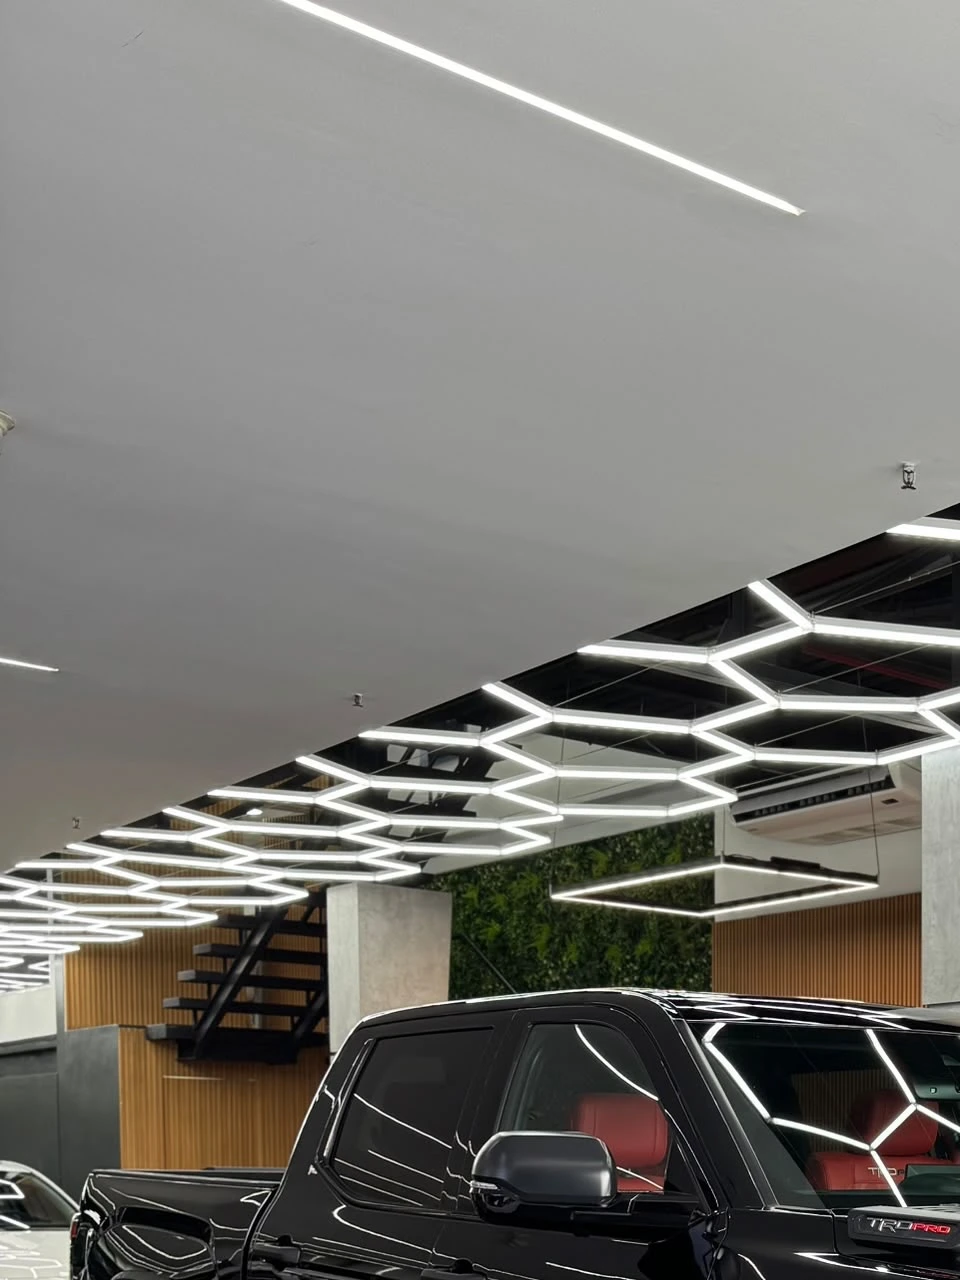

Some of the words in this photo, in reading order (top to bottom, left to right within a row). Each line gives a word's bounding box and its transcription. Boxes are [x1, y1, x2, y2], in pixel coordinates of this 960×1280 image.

[867, 1166, 897, 1178] TD
[867, 1217, 914, 1233] TRD
[912, 1222, 951, 1234] PRO
